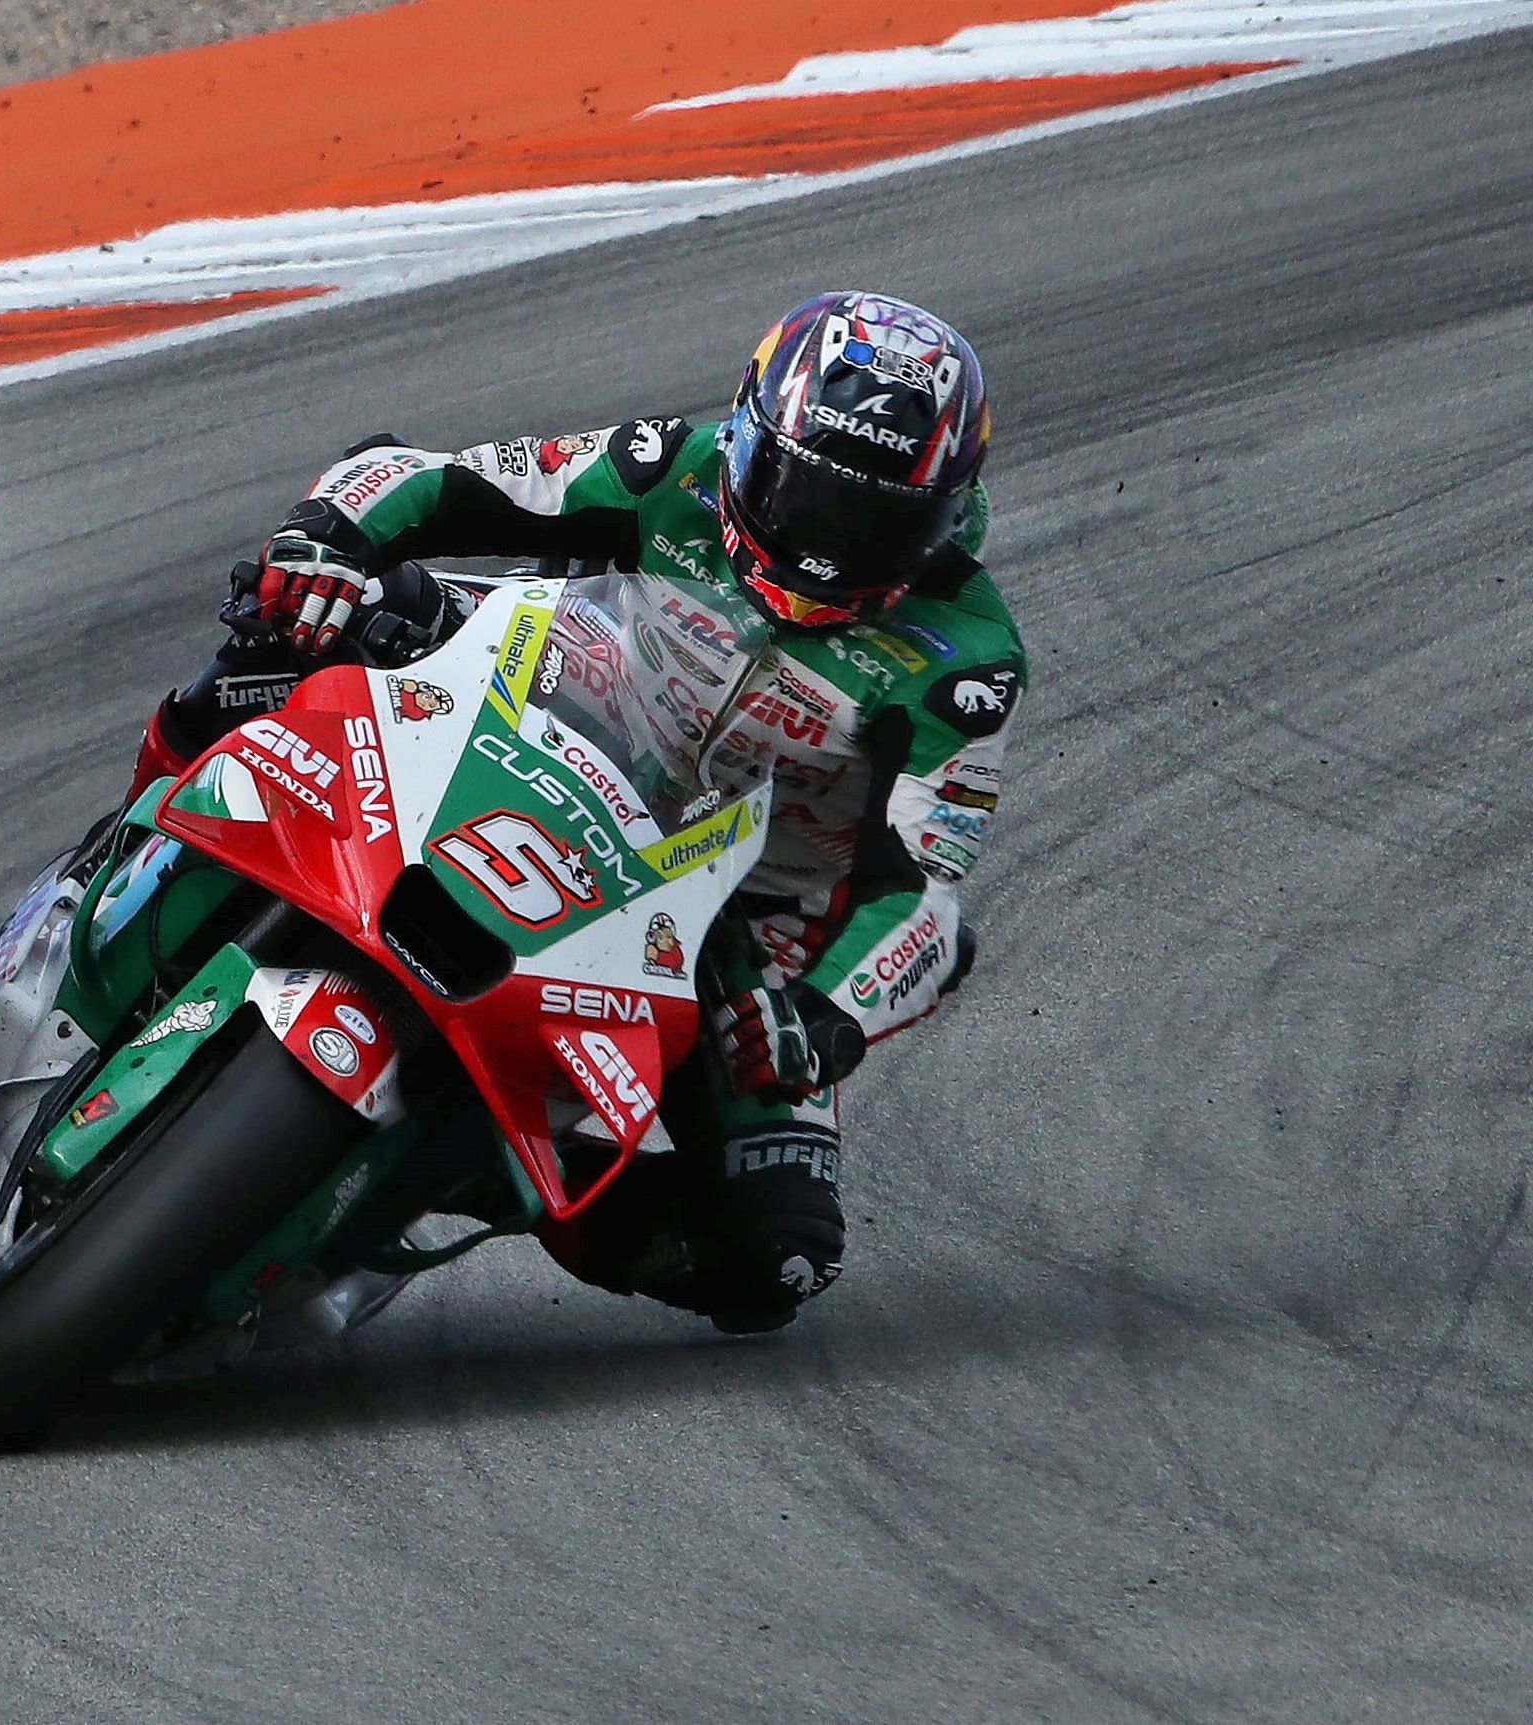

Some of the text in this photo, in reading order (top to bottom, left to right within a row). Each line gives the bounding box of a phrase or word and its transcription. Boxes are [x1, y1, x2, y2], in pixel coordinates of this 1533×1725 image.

[815, 404, 920, 456] SHARK
[341, 462, 406, 513] Castrol
[830, 461, 868, 484] YOU
[651, 533, 730, 596] SHARK
[502, 614, 536, 678] ultimate
[779, 667, 839, 713] Castrol
[238, 746, 335, 822] HONDA
[239, 718, 341, 789] GIVI
[343, 716, 393, 844] SENA
[564, 746, 637, 827] Castrol
[472, 733, 643, 897] CUSTOM
[430, 808, 602, 931] 5
[661, 828, 726, 872] ultimate
[385, 931, 449, 996] DAYCO
[876, 911, 939, 982] Castrol
[540, 983, 656, 1026] SENA
[553, 1034, 628, 1138] HONDA
[579, 1030, 657, 1123] GIVI
